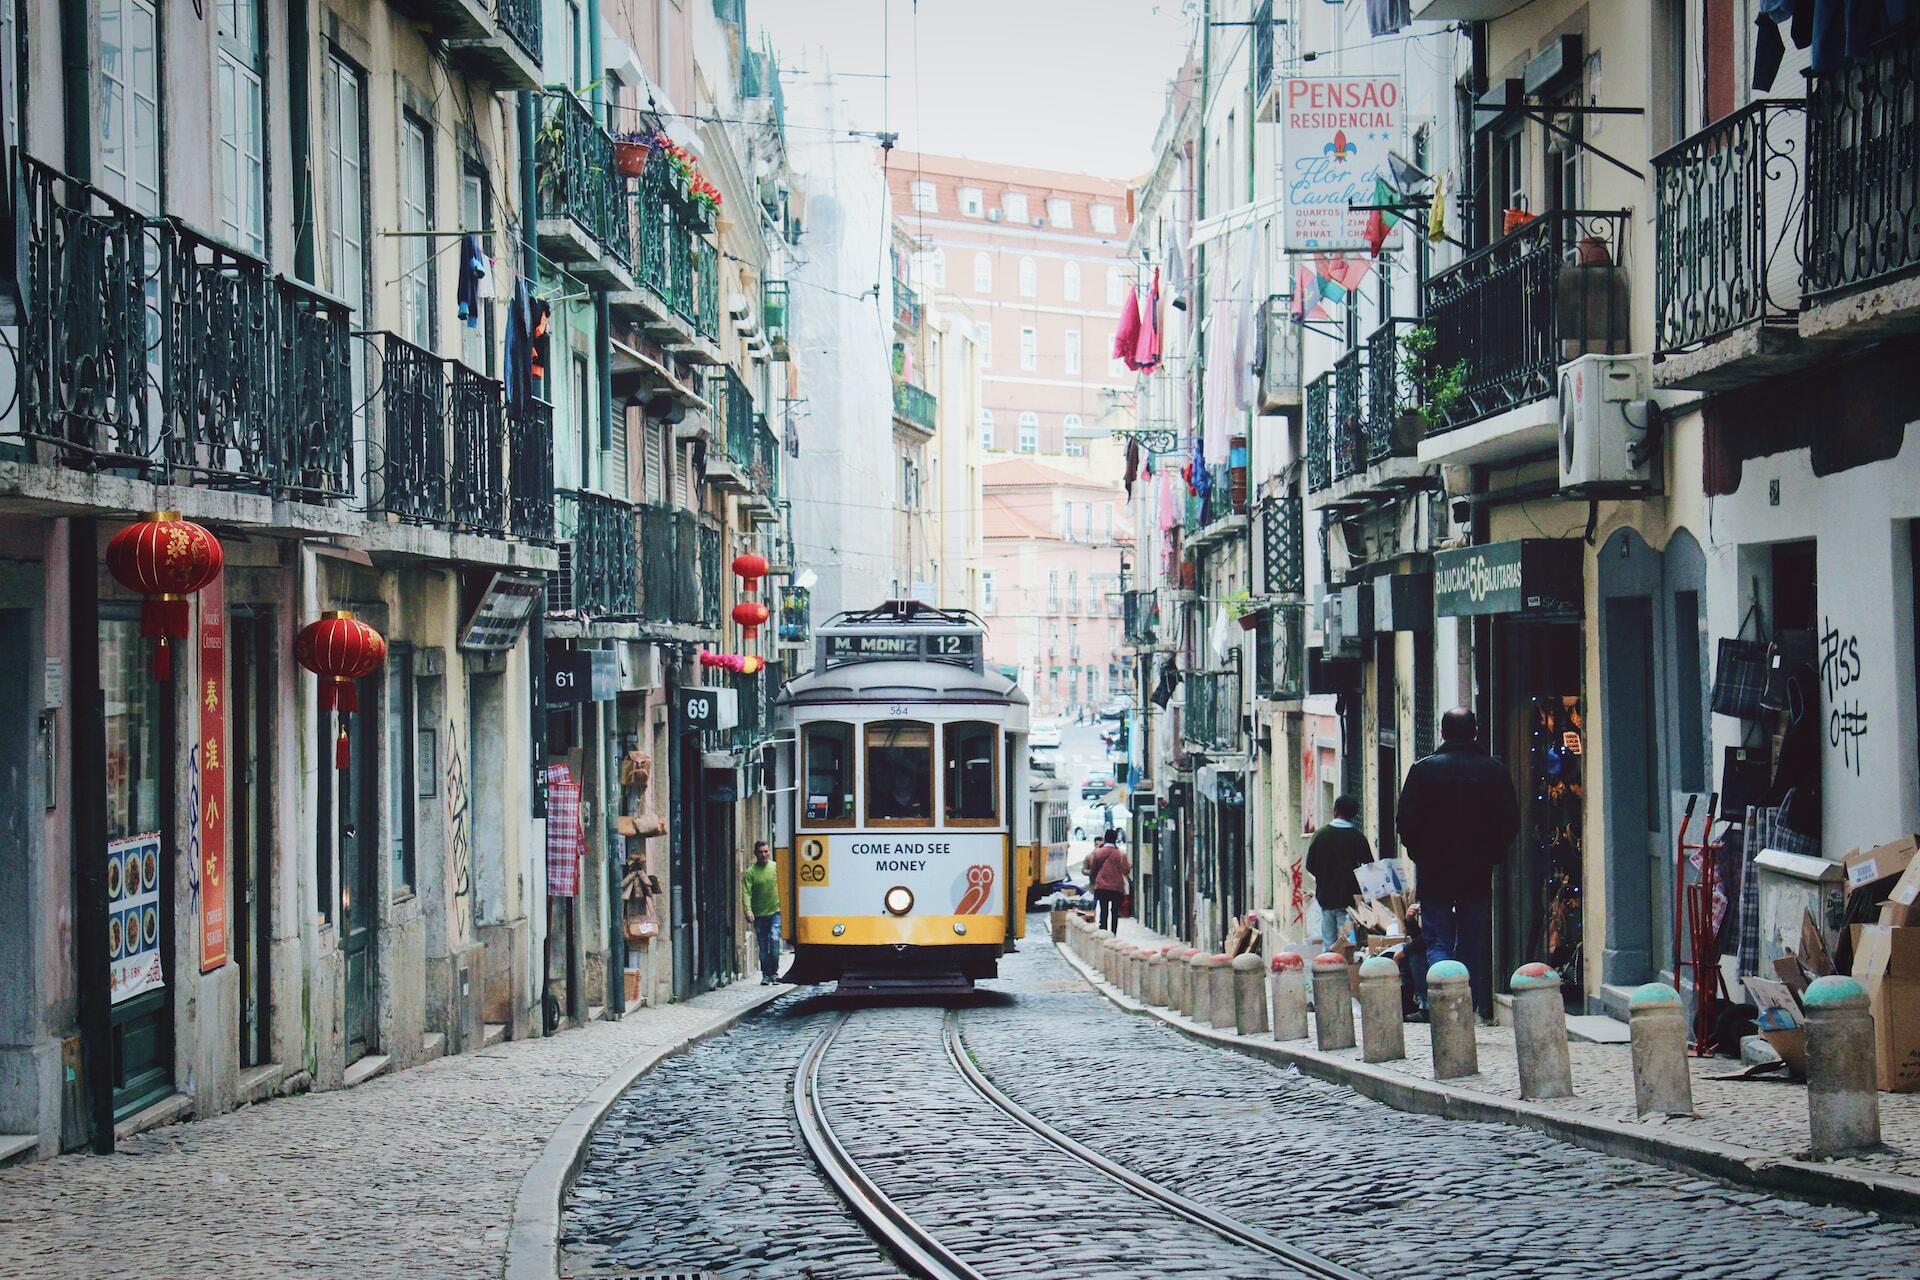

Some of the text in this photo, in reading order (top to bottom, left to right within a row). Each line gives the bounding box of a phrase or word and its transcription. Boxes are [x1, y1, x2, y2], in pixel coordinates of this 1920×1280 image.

[1290, 112, 1394, 128] RESIDENCIAL
[1295, 157, 1351, 184] Flor
[1295, 209, 1340, 217] QUARTOS
[1469, 555, 1486, 602] 56
[1484, 561, 1522, 592] BIJUTARIAS
[861, 638, 918, 651] MONIZ
[937, 636, 961, 654] 12
[555, 671, 574, 687] 61
[687, 699, 709, 719] 69
[889, 706, 908, 716] 564
[851, 843, 951, 854] COME AND SEE
[876, 860, 926, 871] MONEY
